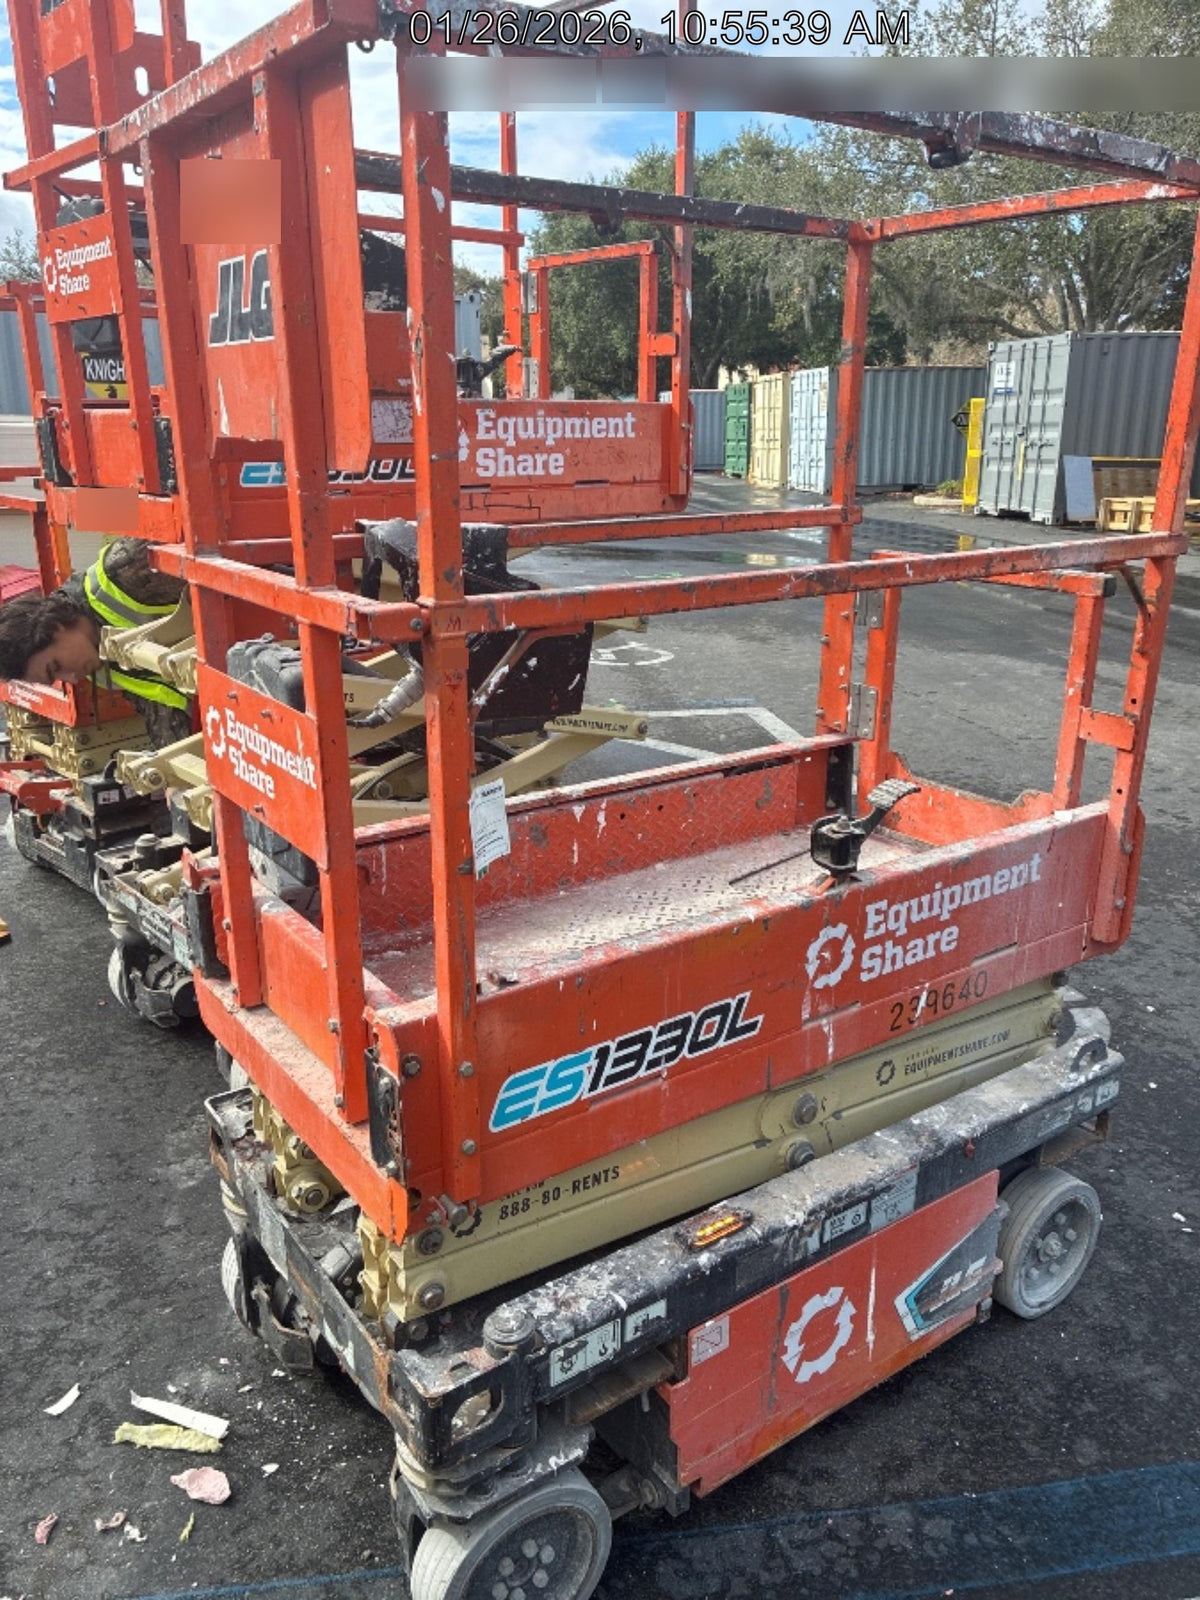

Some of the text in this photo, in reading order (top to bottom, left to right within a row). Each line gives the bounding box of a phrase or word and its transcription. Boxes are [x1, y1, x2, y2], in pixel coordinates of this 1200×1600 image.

[55, 235, 113, 272] Equipment
[59, 272, 90, 296] Share
[84, 358, 126, 381] KNIGH
[475, 408, 636, 447] Equipment
[475, 447, 565, 478] Share
[225, 707, 318, 791] Equipment
[228, 745, 276, 800] Share
[864, 853, 1043, 940] Equipment
[860, 925, 960, 983] Share
[889, 969, 988, 1032] 239640
[489, 990, 765, 1133] ES1330L
[499, 1165, 620, 1220] 888-80-RENTS
